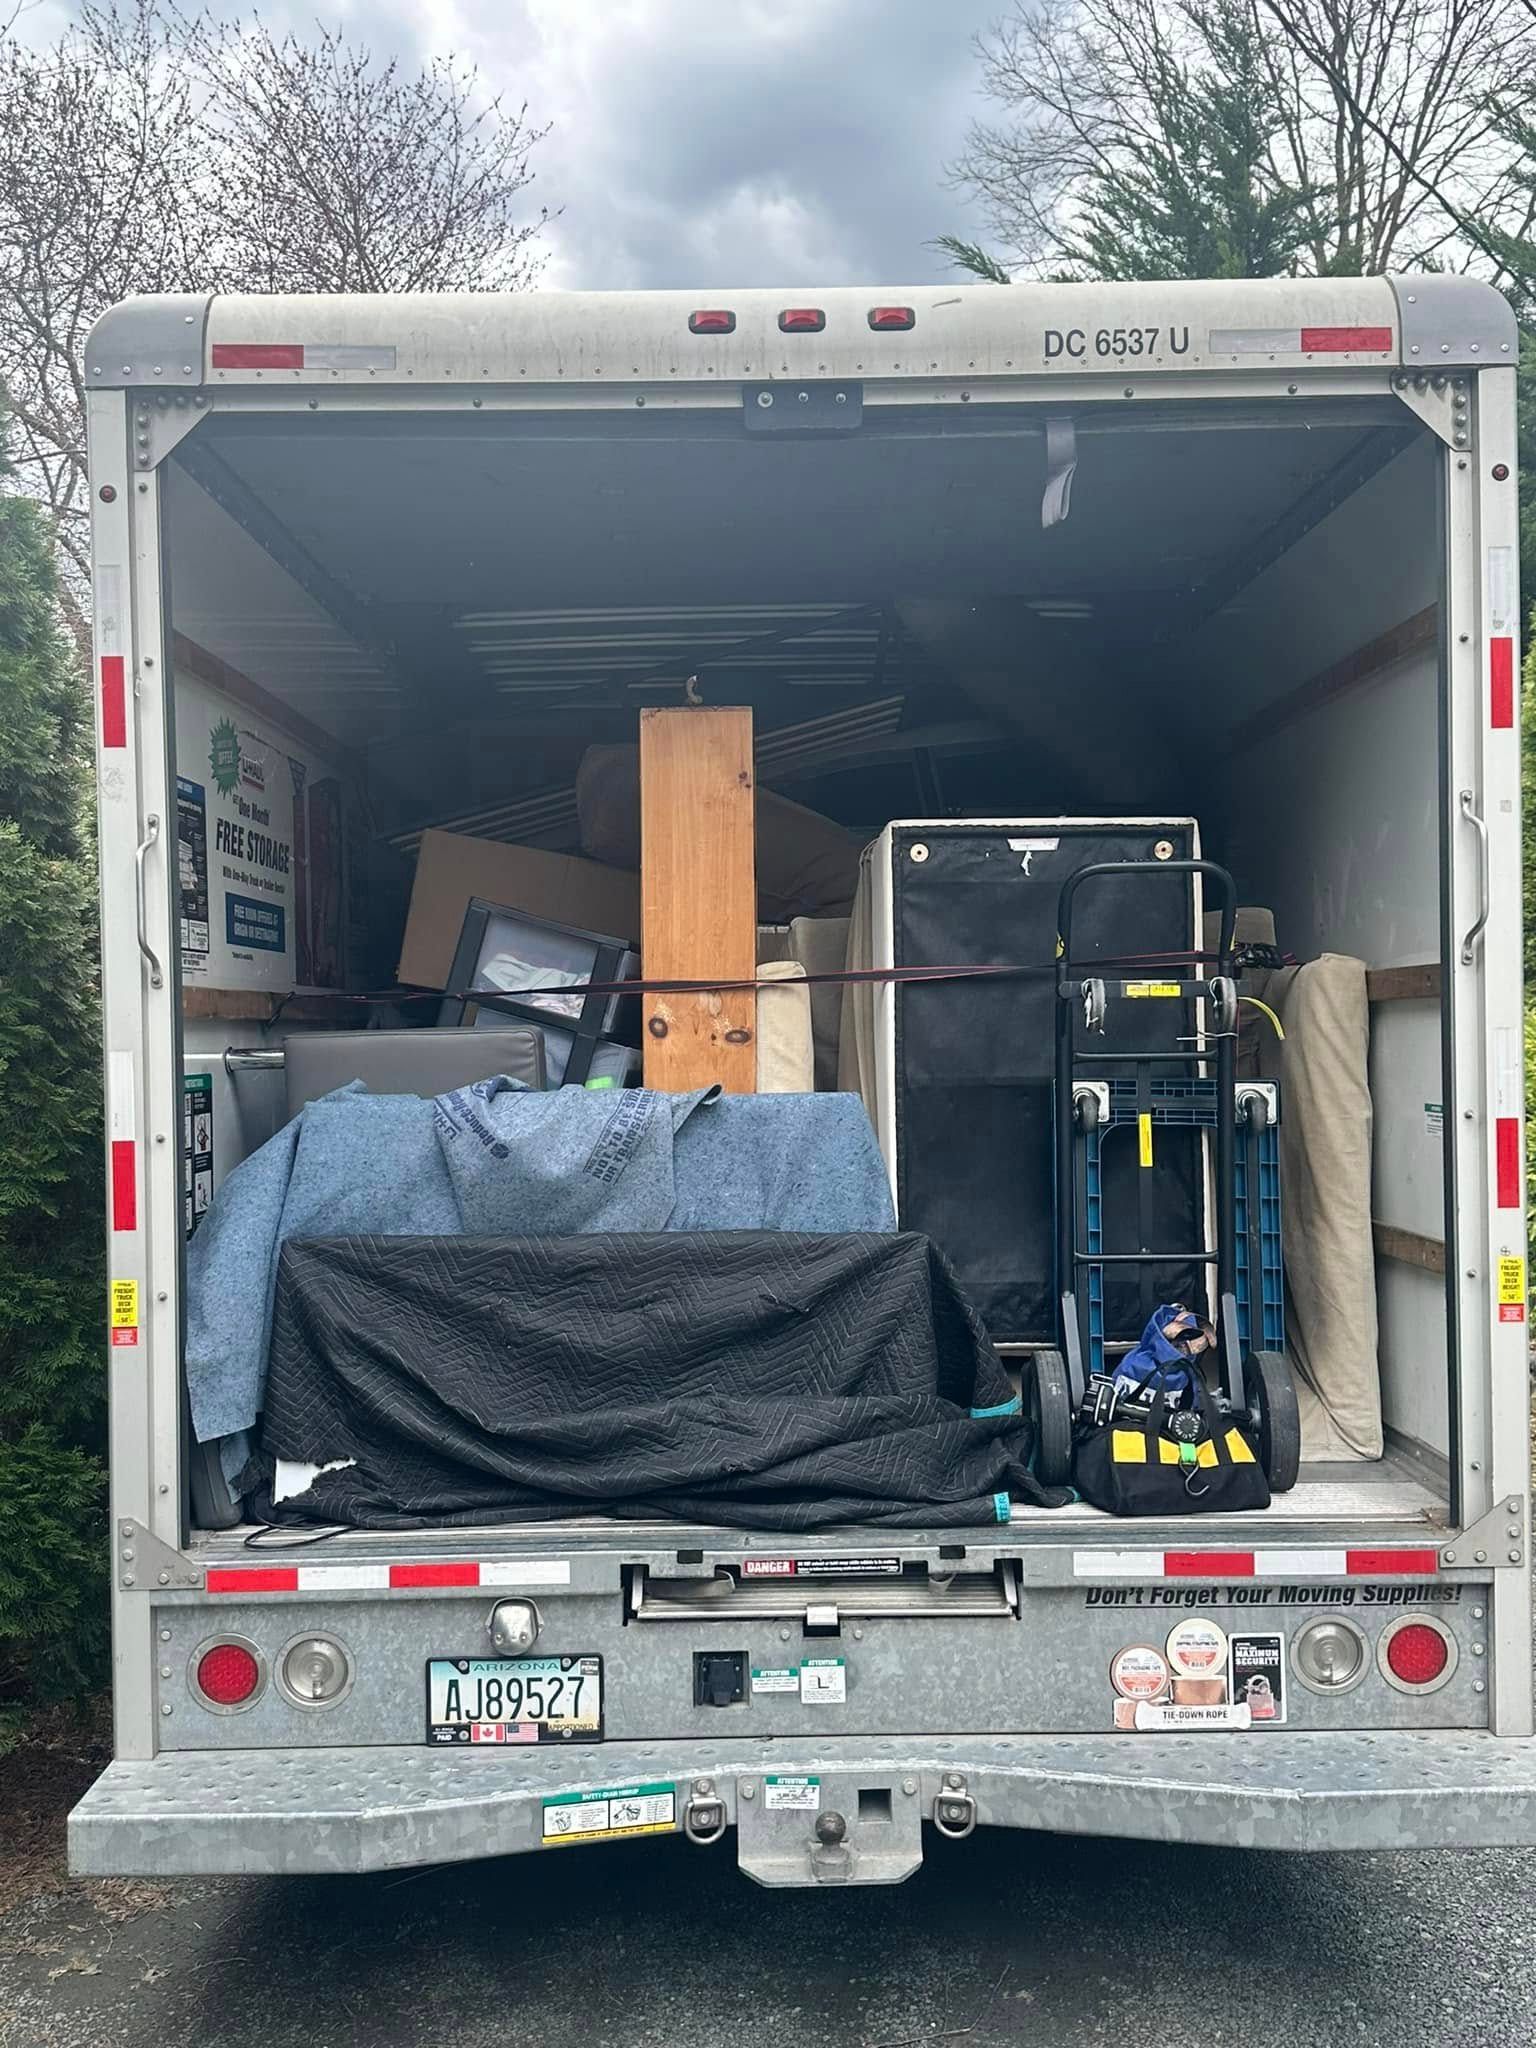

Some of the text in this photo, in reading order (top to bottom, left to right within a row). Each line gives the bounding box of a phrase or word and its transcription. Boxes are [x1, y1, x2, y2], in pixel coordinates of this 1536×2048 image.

[1044, 327, 1189, 358] DC 6537 U
[239, 796, 251, 818] One
[215, 817, 290, 874] FREE STORAGE
[591, 1151, 613, 1179] NOT
[608, 1132, 623, 1148] TO
[618, 1113, 632, 1128] BE
[602, 1165, 617, 1183] OR
[747, 1561, 790, 1573] DANGER
[1151, 1586, 1219, 1608] Forget
[1227, 1586, 1272, 1604] Your
[1279, 1585, 1356, 1606] Moving
[1363, 1584, 1463, 1605] Supplies!
[1235, 1649, 1279, 1657] MAXIMUM
[1235, 1657, 1279, 1665] SECURITY
[473, 1662, 559, 1672] ARIZONA
[445, 1676, 584, 1721] AJ89527
[1163, 1709, 1228, 1719] TIE-DOWN ROPE
